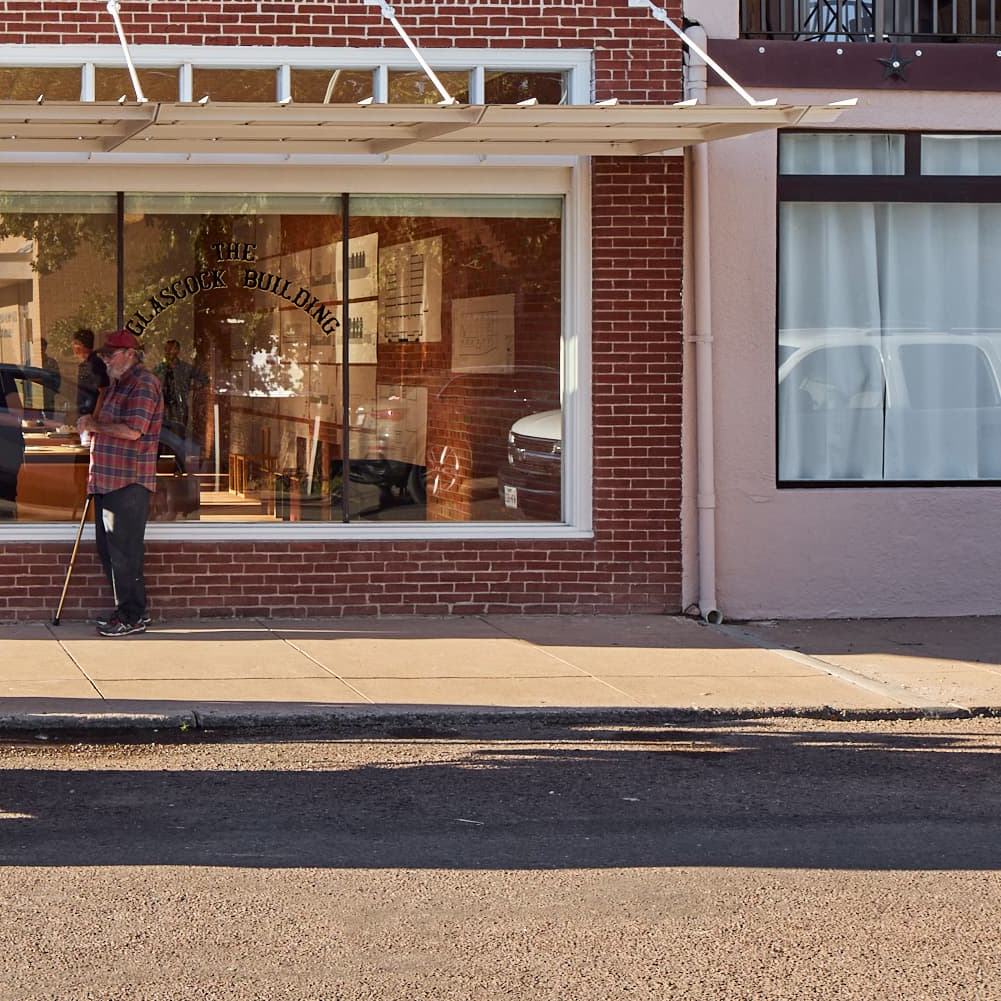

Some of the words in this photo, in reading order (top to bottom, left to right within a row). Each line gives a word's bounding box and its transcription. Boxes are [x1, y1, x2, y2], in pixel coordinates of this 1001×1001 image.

[211, 243, 258, 263] THE
[126, 270, 227, 337] GLASCOCK
[243, 270, 341, 336] BUILDING
